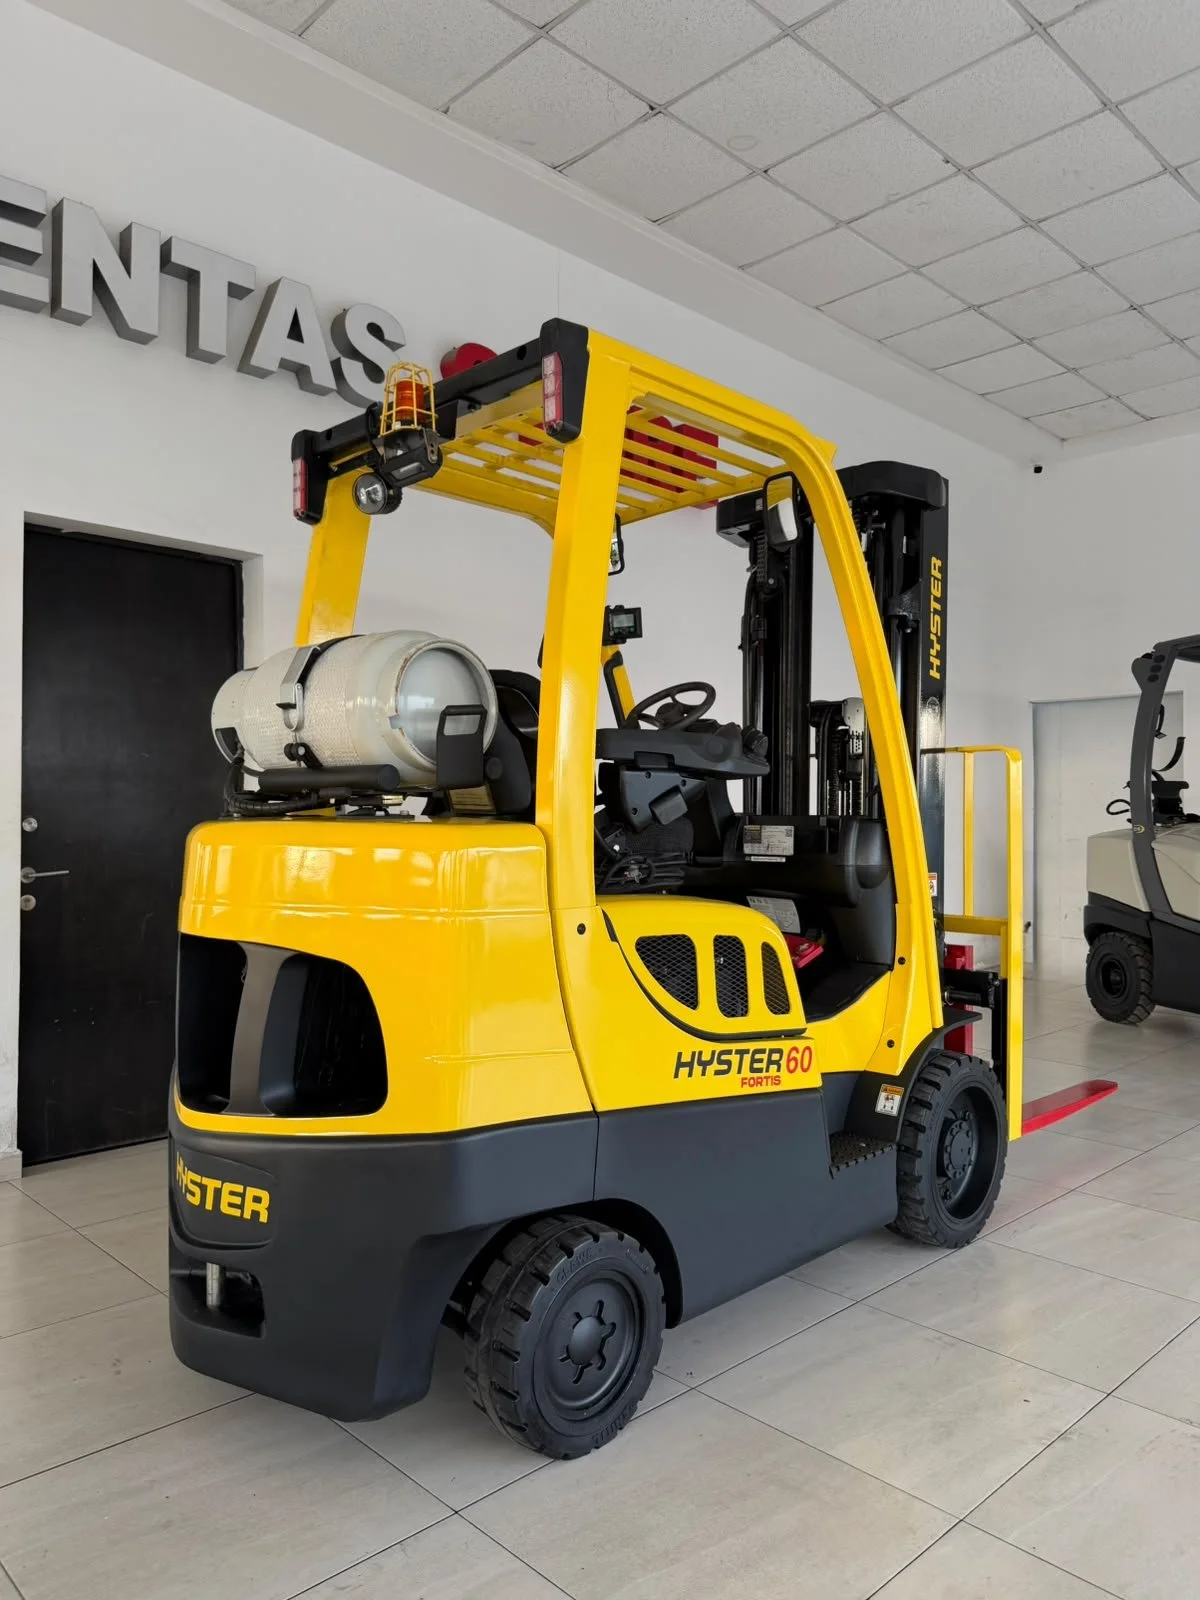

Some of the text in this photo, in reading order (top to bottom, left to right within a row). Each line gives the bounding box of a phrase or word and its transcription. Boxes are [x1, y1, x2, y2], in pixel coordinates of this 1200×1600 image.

[929, 556, 942, 680] HYSTER
[673, 1045, 813, 1079] HYSTER 60
[740, 1075, 782, 1088] FORTIS
[176, 1151, 270, 1224] HYSTER
